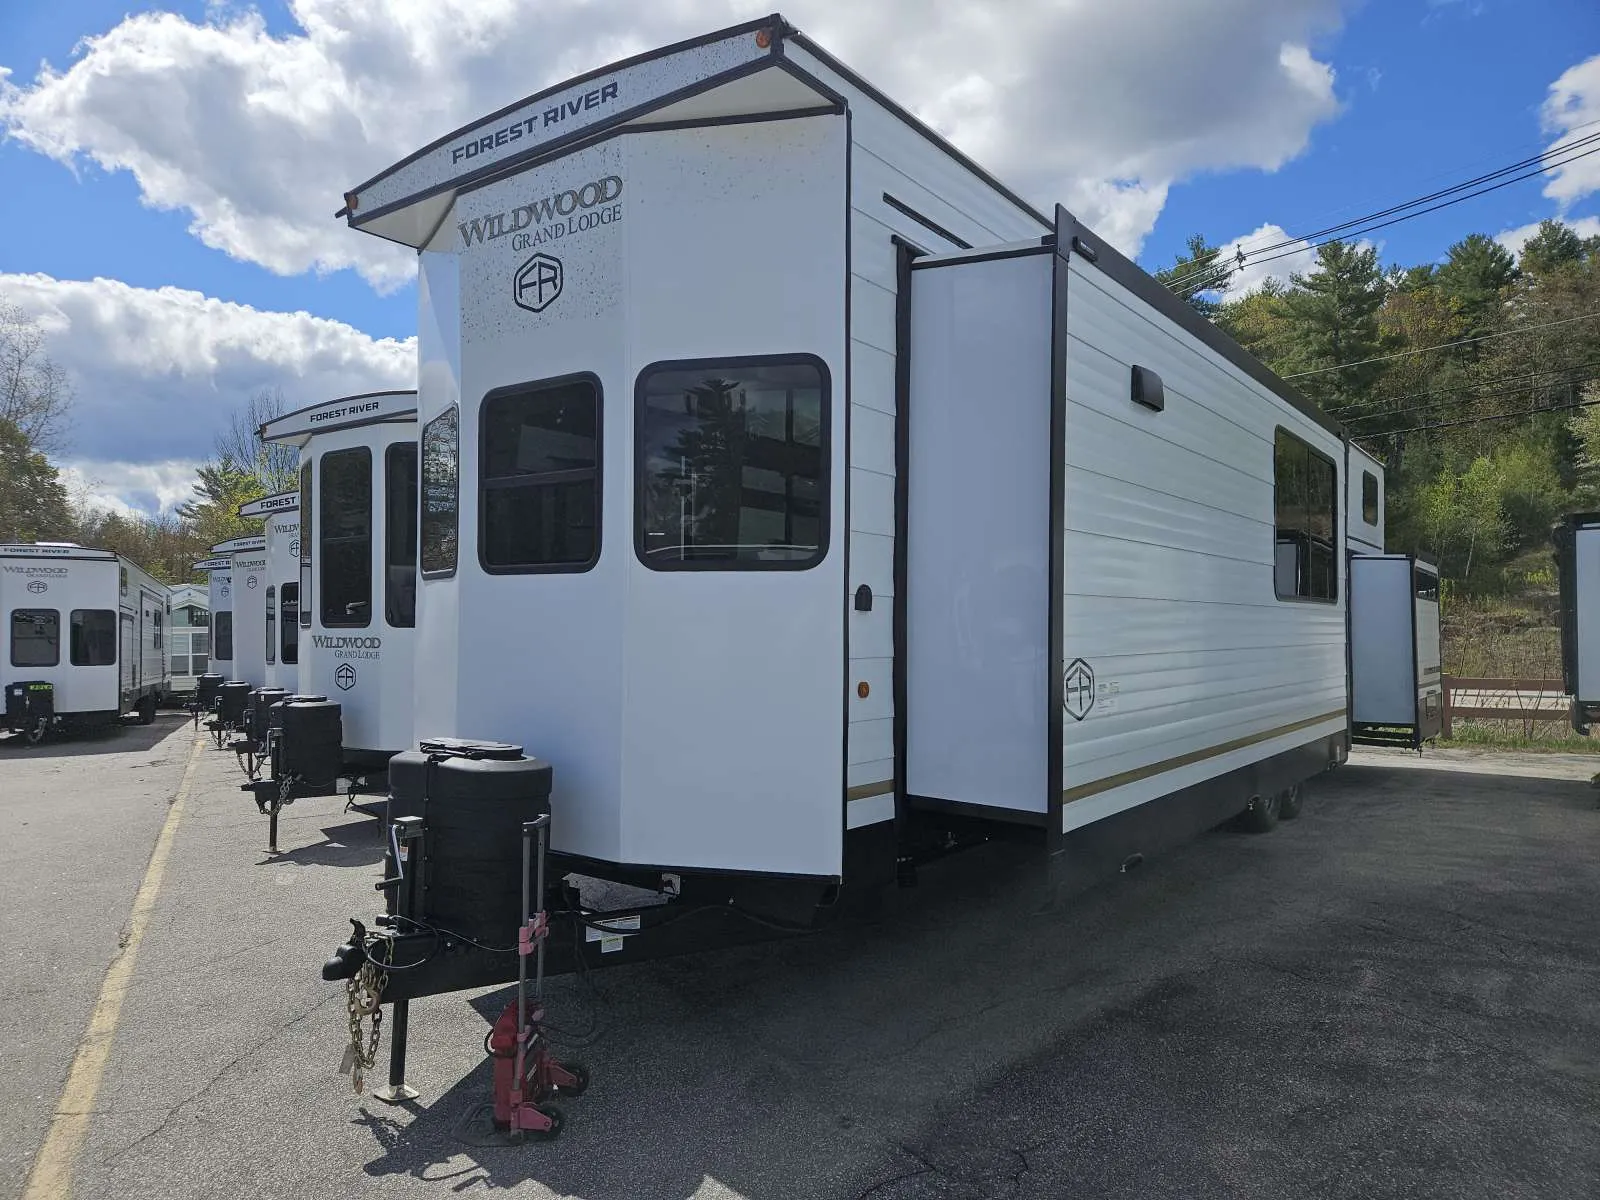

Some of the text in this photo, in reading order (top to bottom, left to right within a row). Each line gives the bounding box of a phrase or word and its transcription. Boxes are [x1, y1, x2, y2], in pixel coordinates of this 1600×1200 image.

[452, 81, 619, 165] FOREST RIVER
[457, 175, 624, 247] WILDWOOD
[512, 204, 622, 251] GRAND LODGE
[310, 401, 379, 422] FOREST RIVER
[260, 496, 296, 509] FOREST
[312, 635, 381, 649] WILDWOOD
[335, 649, 358, 659] GRAND
